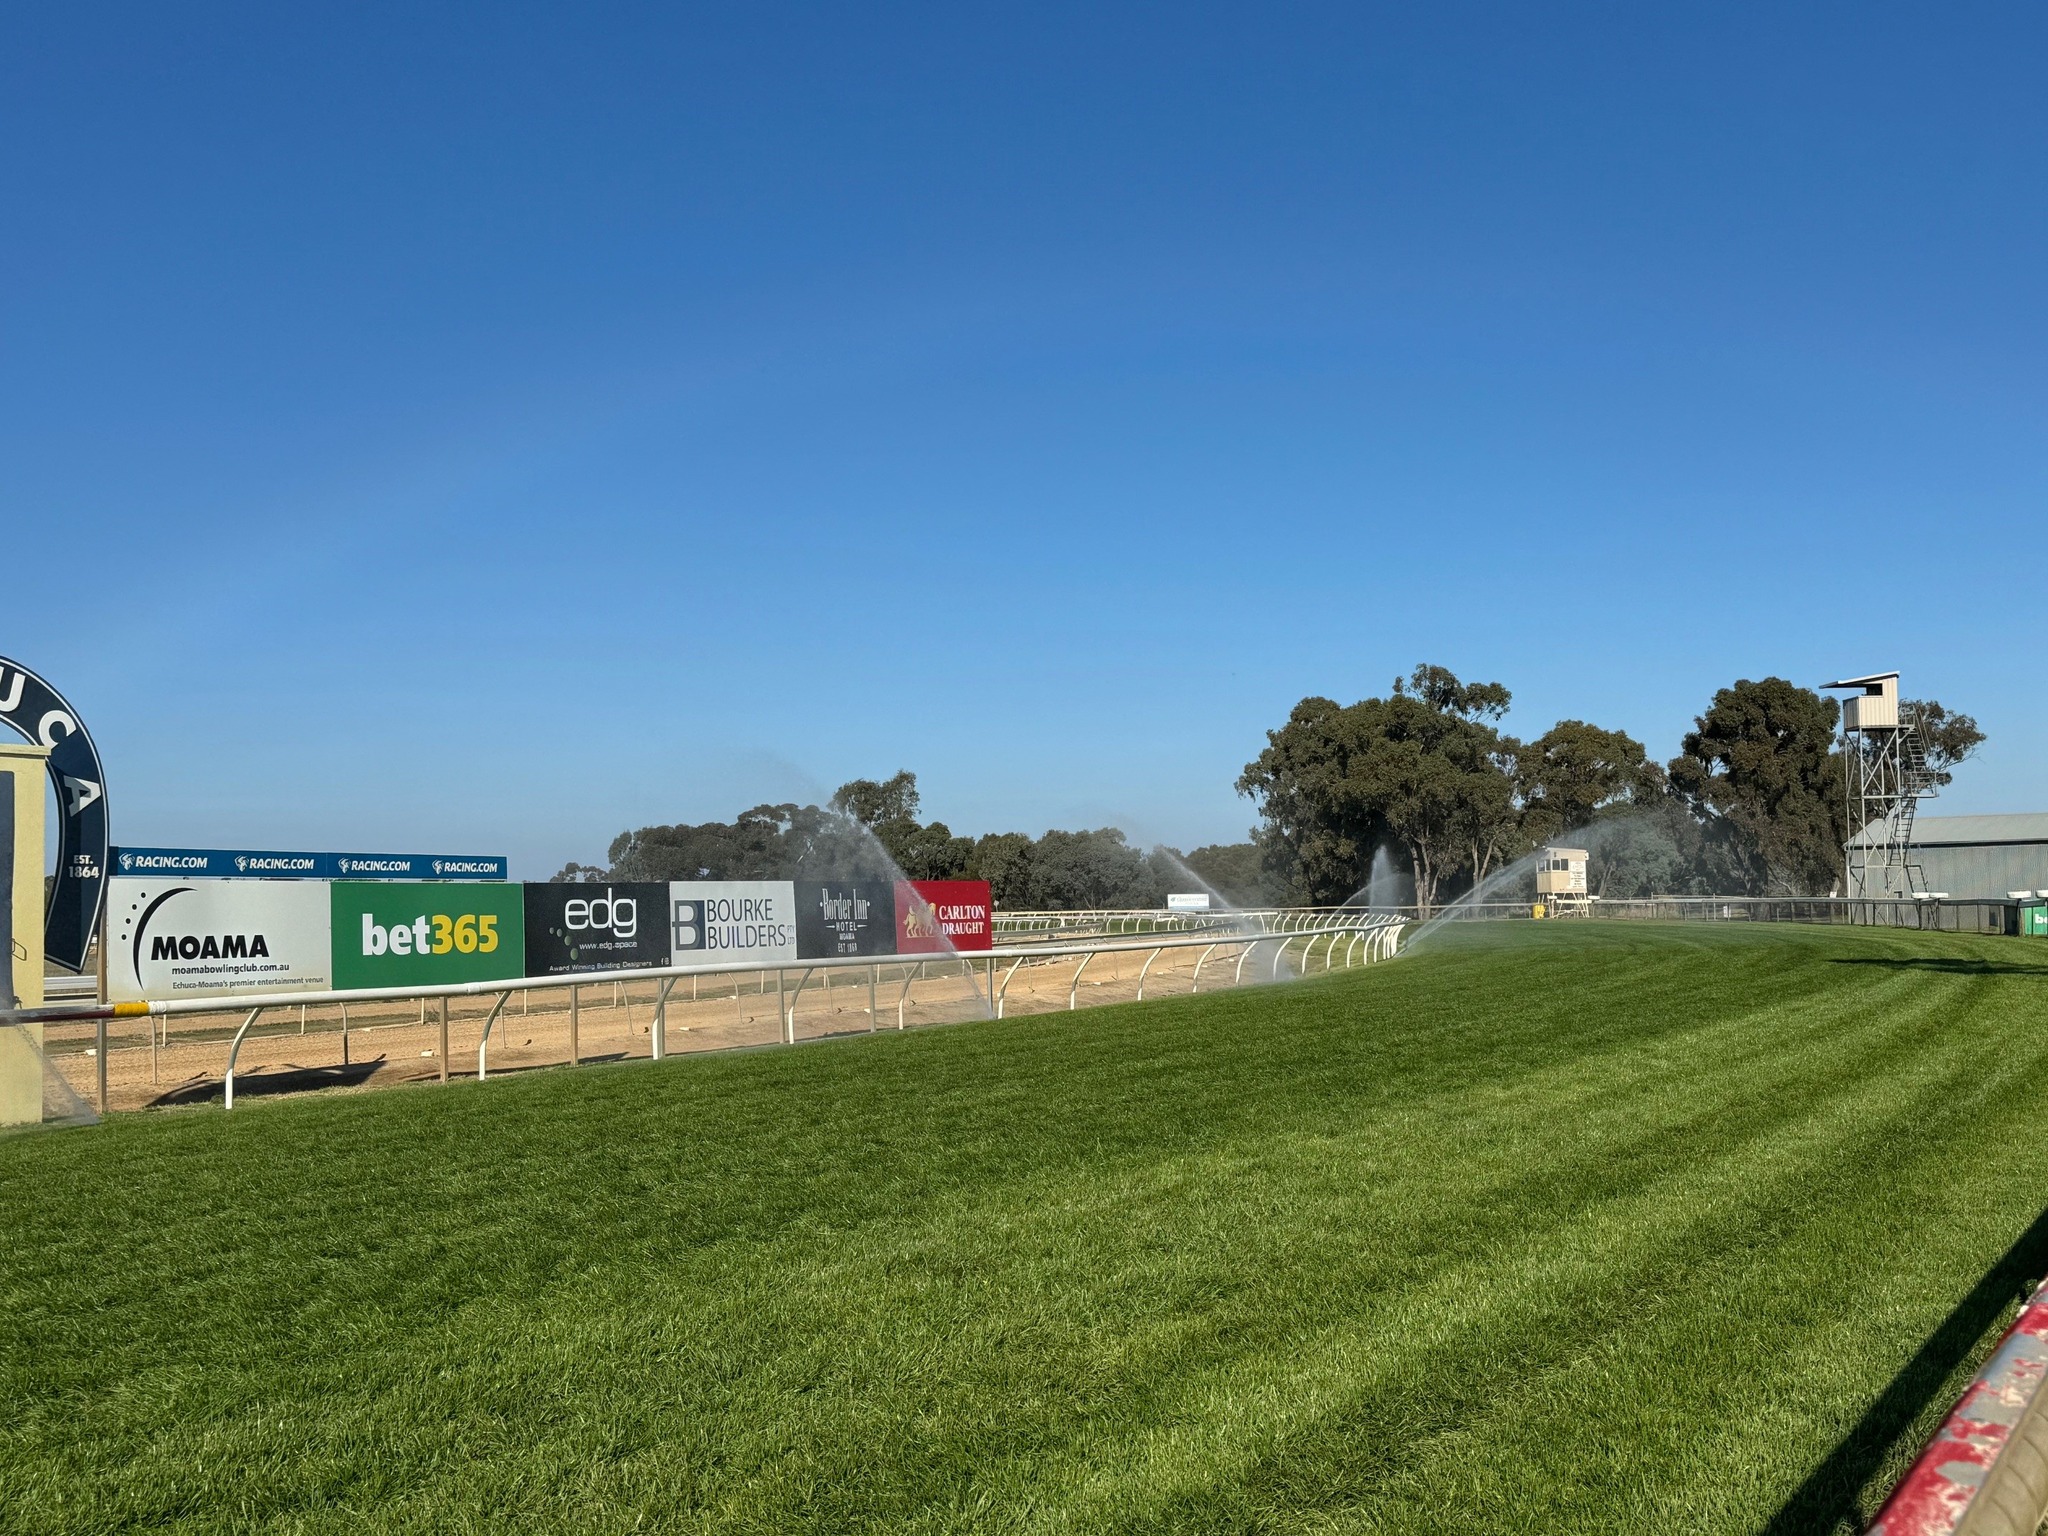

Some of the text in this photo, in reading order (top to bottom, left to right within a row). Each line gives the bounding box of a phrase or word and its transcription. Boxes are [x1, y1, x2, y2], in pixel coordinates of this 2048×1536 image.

[73, 854, 94, 865] EST.
[135, 855, 208, 869] RACING.COM
[249, 857, 315, 870] RACING.COM
[351, 860, 411, 872] RACING.COM
[68, 866, 100, 879] 1864
[444, 862, 498, 873] RACING.COM
[707, 899, 773, 922] BOURKE
[822, 888, 868, 920] Border Inn
[565, 887, 637, 938] edg
[939, 905, 986, 920] CARLTON
[362, 913, 499, 956] bet365
[942, 922, 985, 935] DRAUGHT
[708, 924, 786, 950] BUILDERS
[151, 934, 270, 961] MOAMA
[171, 962, 290, 976] moamabowlingclub.com.au
[549, 960, 653, 972] Award Winning Building Designers
[172, 976, 324, 990] Echuca-Moama's premier entertainment venue
